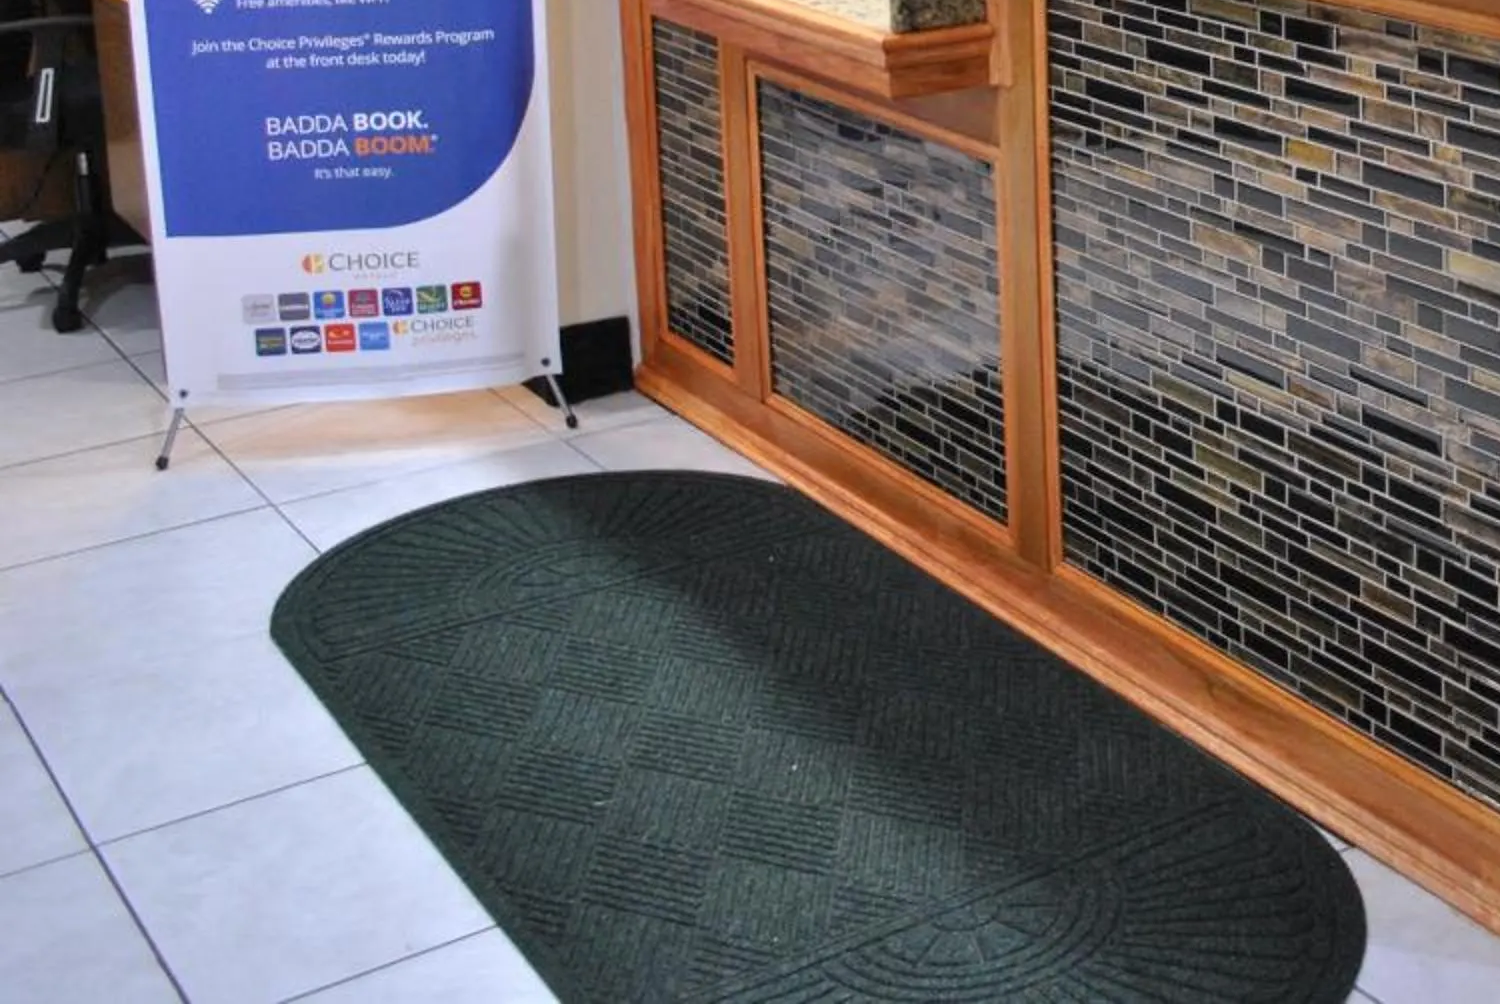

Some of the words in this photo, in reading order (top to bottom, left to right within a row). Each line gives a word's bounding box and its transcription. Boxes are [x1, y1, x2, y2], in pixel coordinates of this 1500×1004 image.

[191, 40, 219, 56] Join
[222, 38, 245, 52] the
[249, 37, 296, 50] Choice
[374, 31, 433, 45] Rewards
[435, 28, 494, 45] Program
[266, 57, 280, 69] at
[283, 55, 305, 68] the
[308, 54, 345, 68] front
[347, 52, 378, 65] desk
[382, 51, 426, 67] today!
[266, 114, 348, 136] BADDA
[353, 110, 429, 131] BOOK.
[268, 138, 350, 161] BADDA
[314, 168, 333, 179] It's
[335, 167, 360, 179] that
[362, 167, 394, 180] easy.
[329, 251, 420, 272] CHOICE
[410, 315, 474, 333] CHOICE
